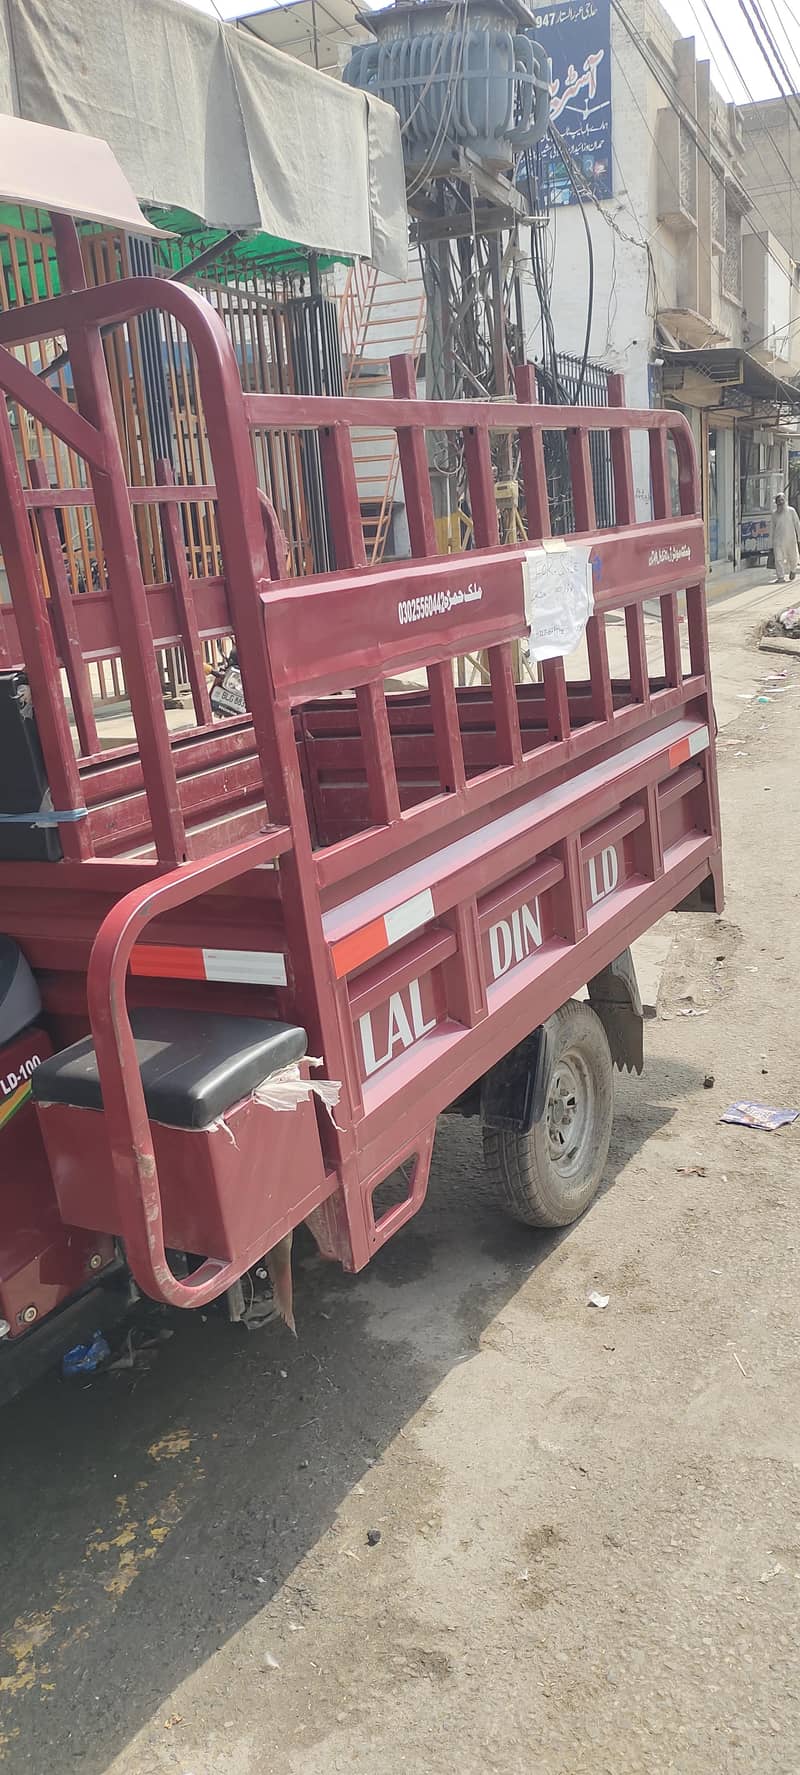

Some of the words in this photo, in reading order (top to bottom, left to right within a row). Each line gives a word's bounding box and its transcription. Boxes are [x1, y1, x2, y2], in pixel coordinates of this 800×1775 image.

[535, 12, 556, 28] 947
[463, 582, 483, 602] ملک
[398, 591, 446, 624] 03025560442
[360, 978, 437, 1076] LAL
[488, 896, 543, 979] DIN
[588, 845, 618, 904] LD
